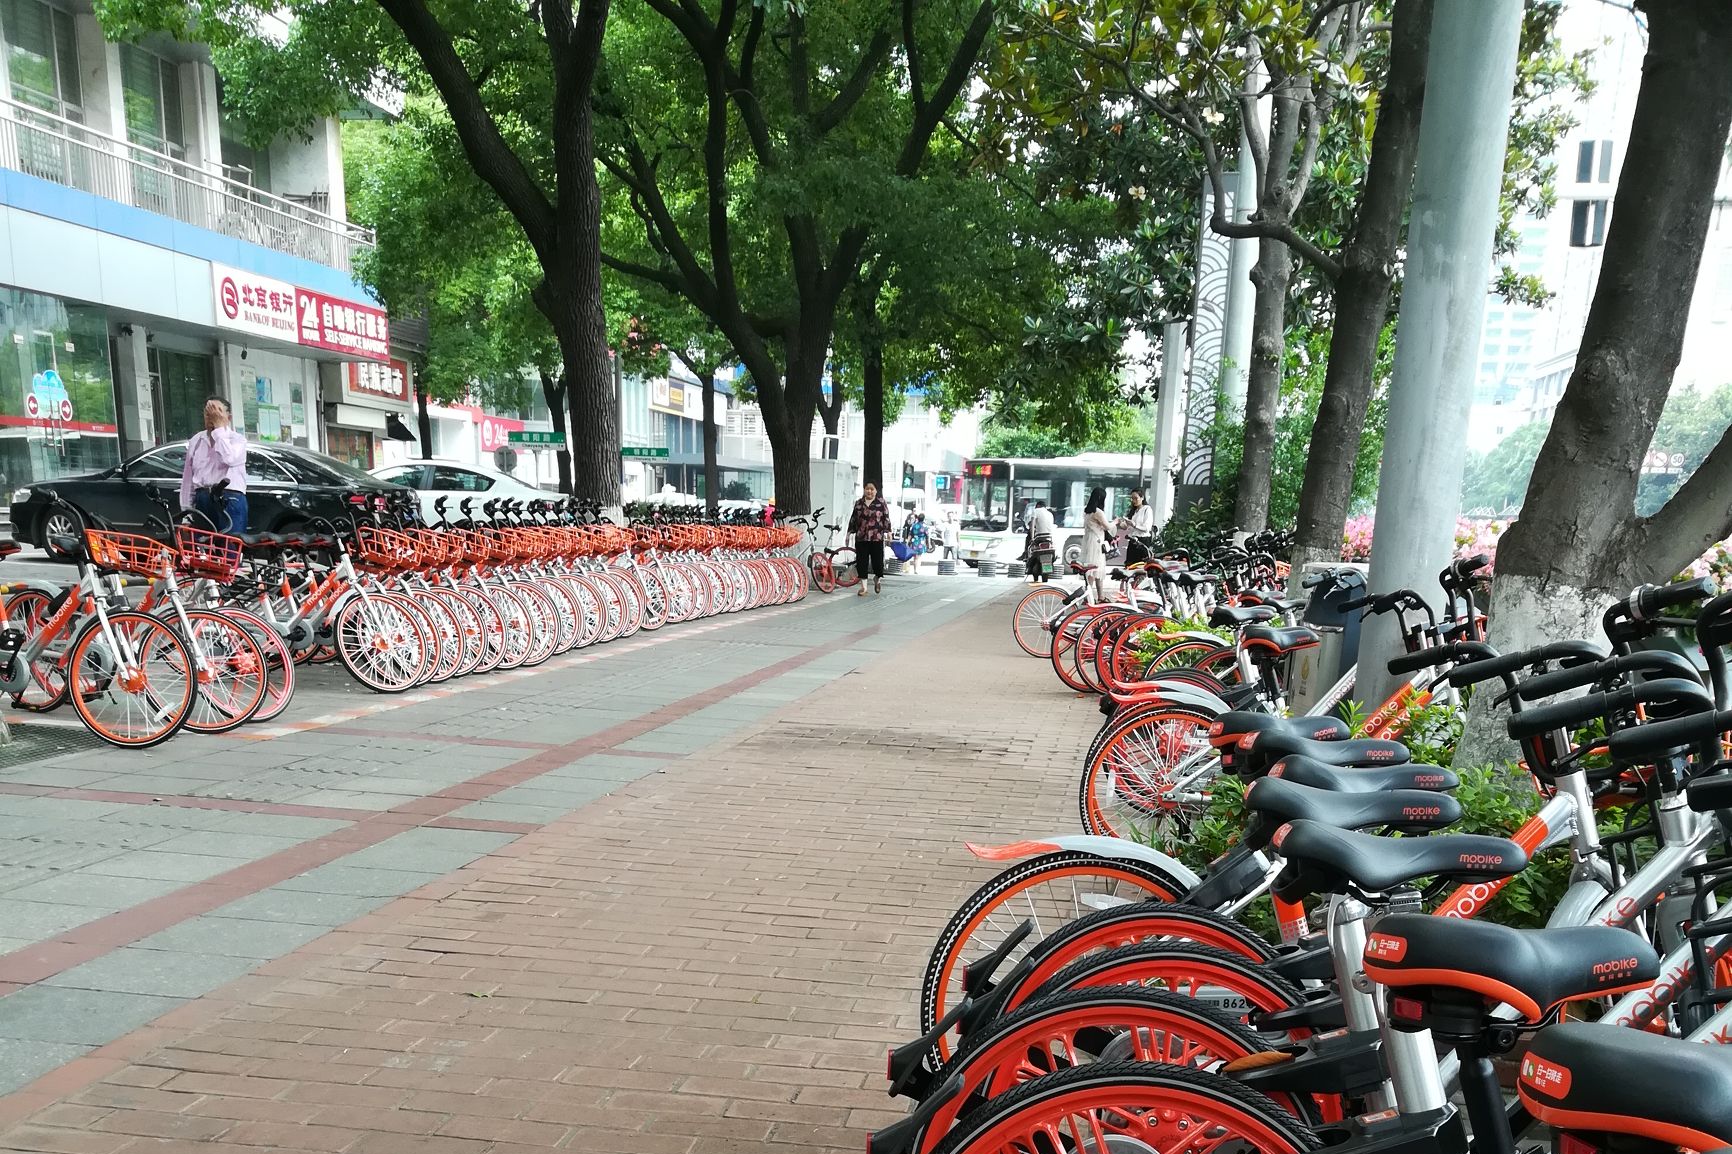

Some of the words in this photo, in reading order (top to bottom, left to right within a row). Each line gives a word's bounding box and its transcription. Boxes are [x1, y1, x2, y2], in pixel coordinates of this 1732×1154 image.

[241, 284, 293, 316] 北京银行
[300, 294, 320, 330] 24
[271, 317, 295, 332] BEIJING
[1366, 750, 1395, 758] mobike
[1414, 775, 1445, 783] mobike
[1402, 806, 1441, 816] mobike
[1459, 854, 1503, 865] mobike
[1592, 957, 1638, 975] mobike
